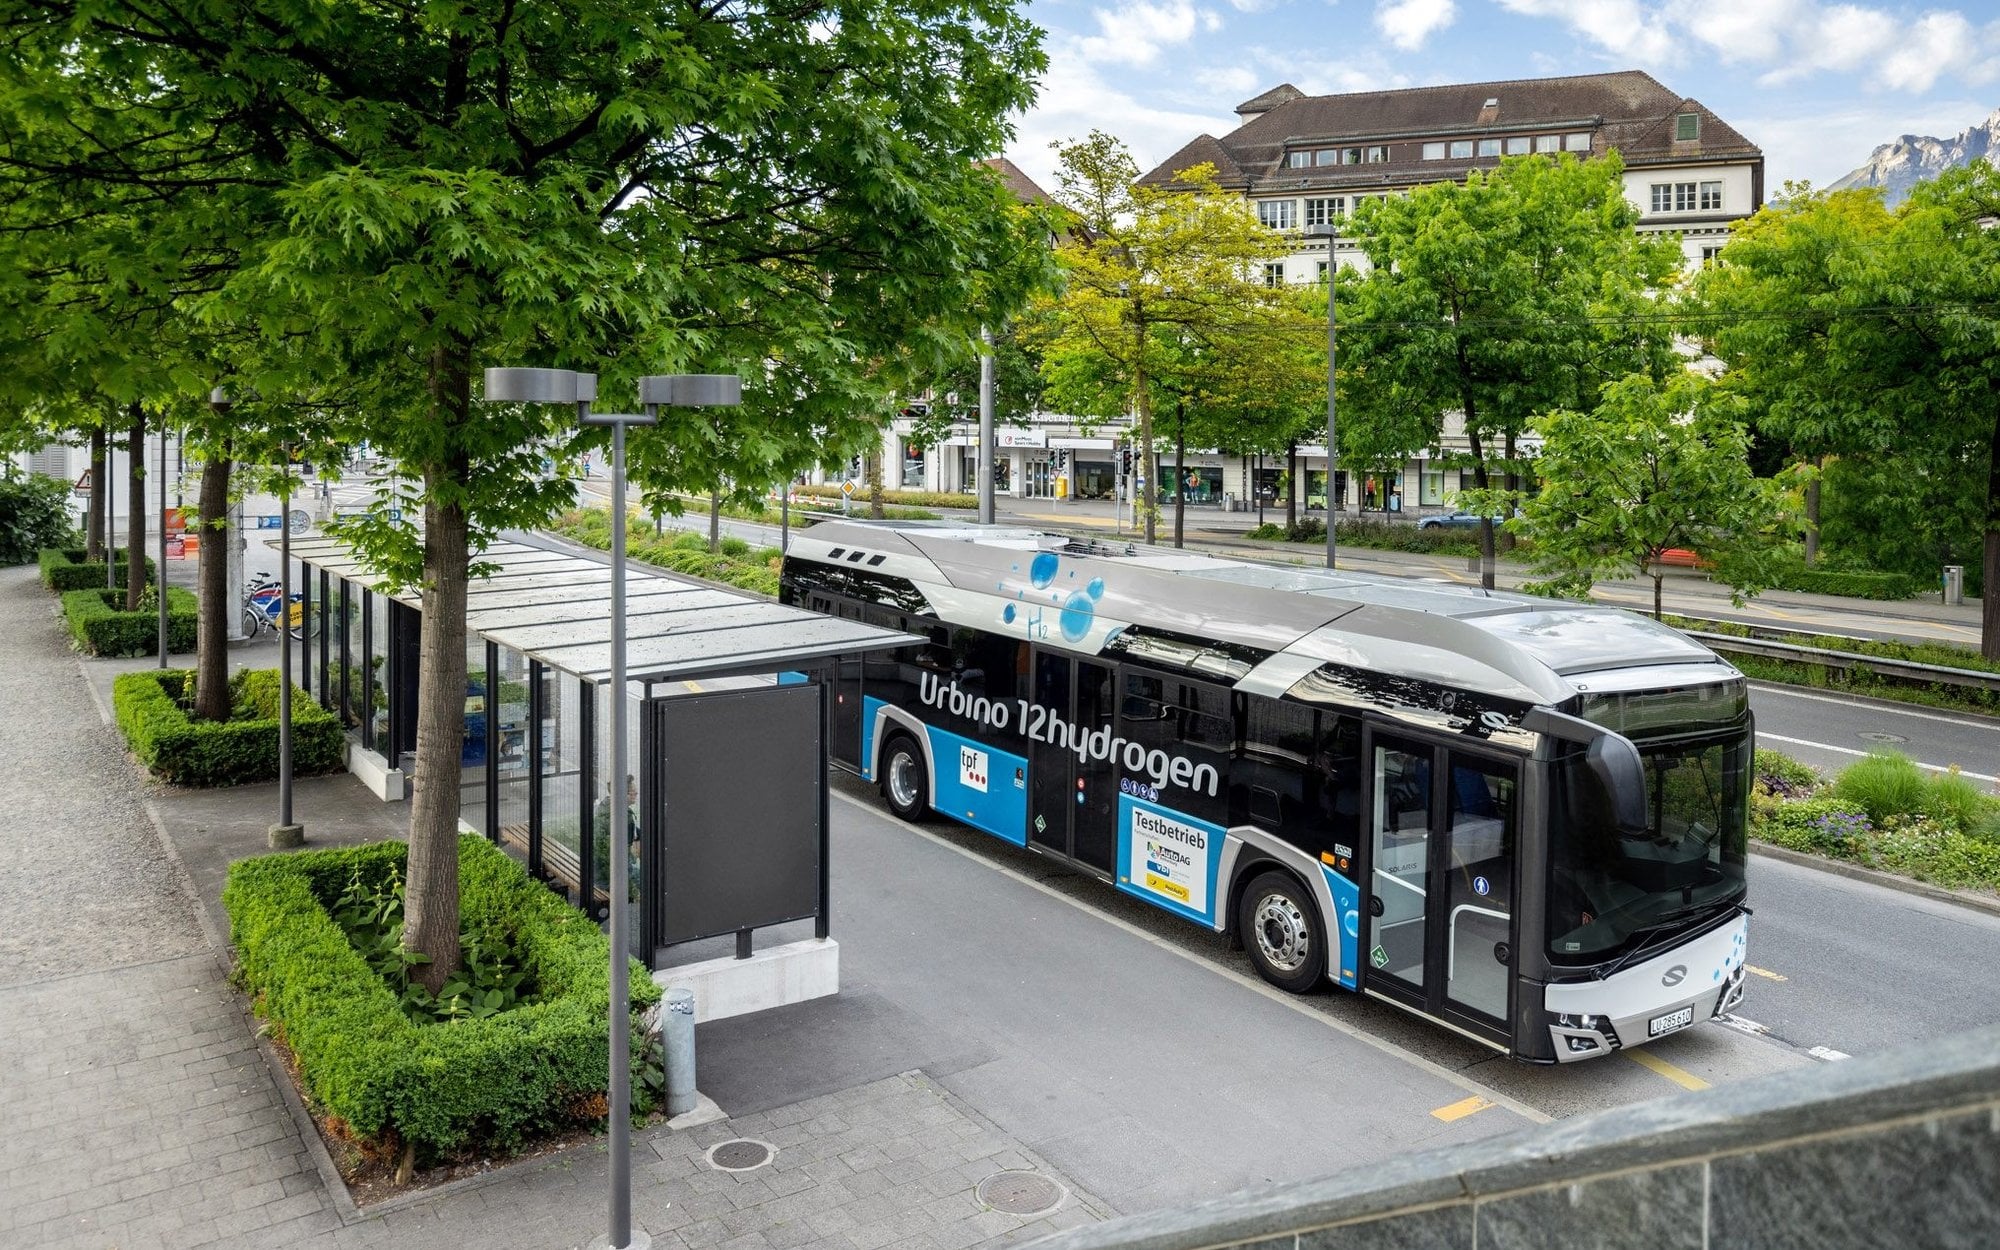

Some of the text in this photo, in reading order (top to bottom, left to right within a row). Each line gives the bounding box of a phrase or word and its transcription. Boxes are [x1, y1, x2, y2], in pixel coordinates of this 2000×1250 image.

[919, 671, 1009, 729] Urbino
[961, 750, 978, 772] tpf
[1134, 811, 1206, 850] Testbetrieb
[1180, 854, 1191, 866] AG
